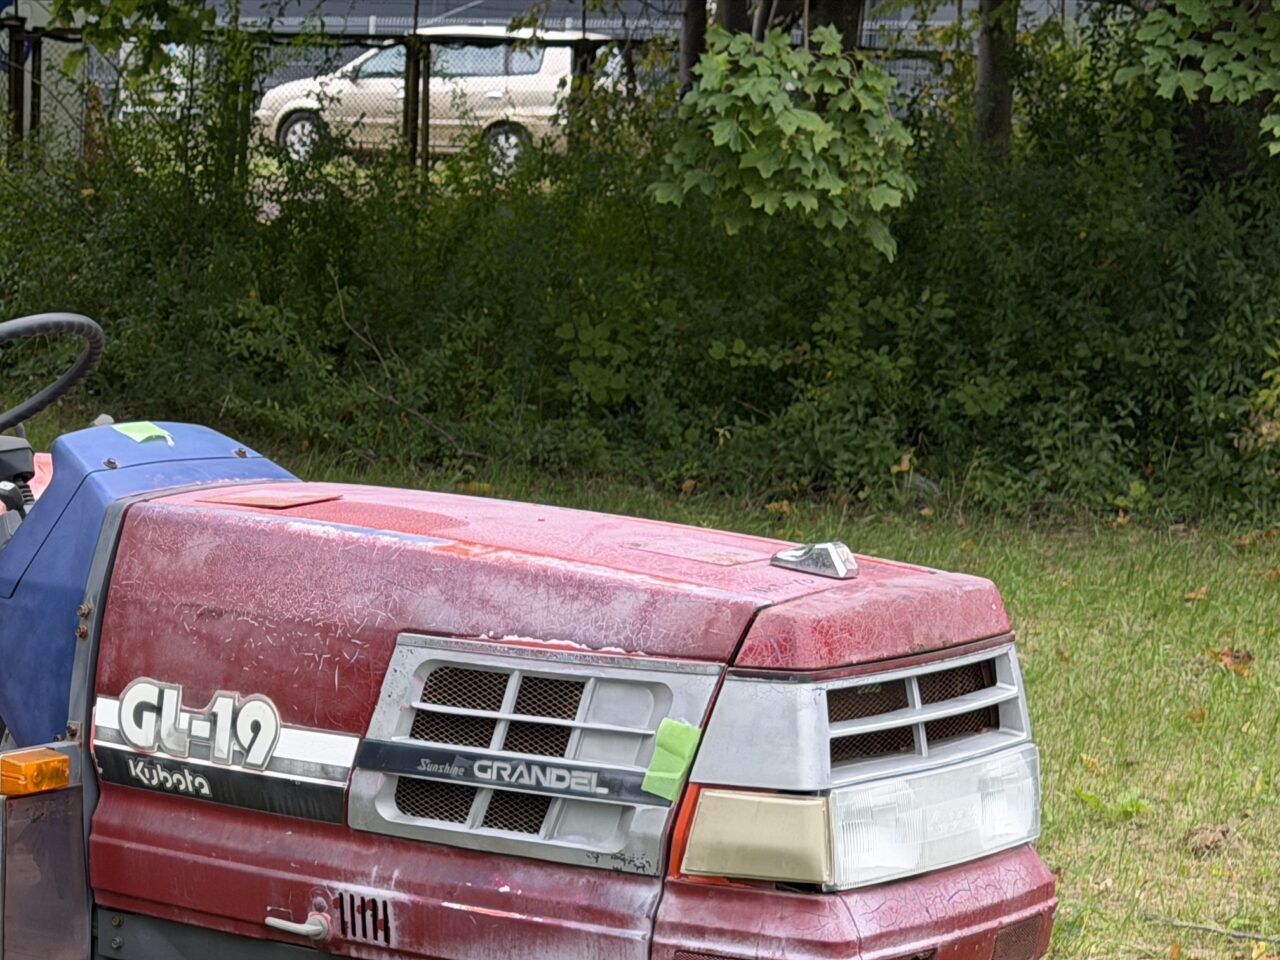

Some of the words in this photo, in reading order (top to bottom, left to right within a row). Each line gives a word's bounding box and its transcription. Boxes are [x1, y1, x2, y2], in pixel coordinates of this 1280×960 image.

[119, 678, 280, 770] GL-19
[127, 757, 213, 798] Kubota
[416, 758, 466, 776] Sunshine
[472, 759, 610, 795] GRANDEL
